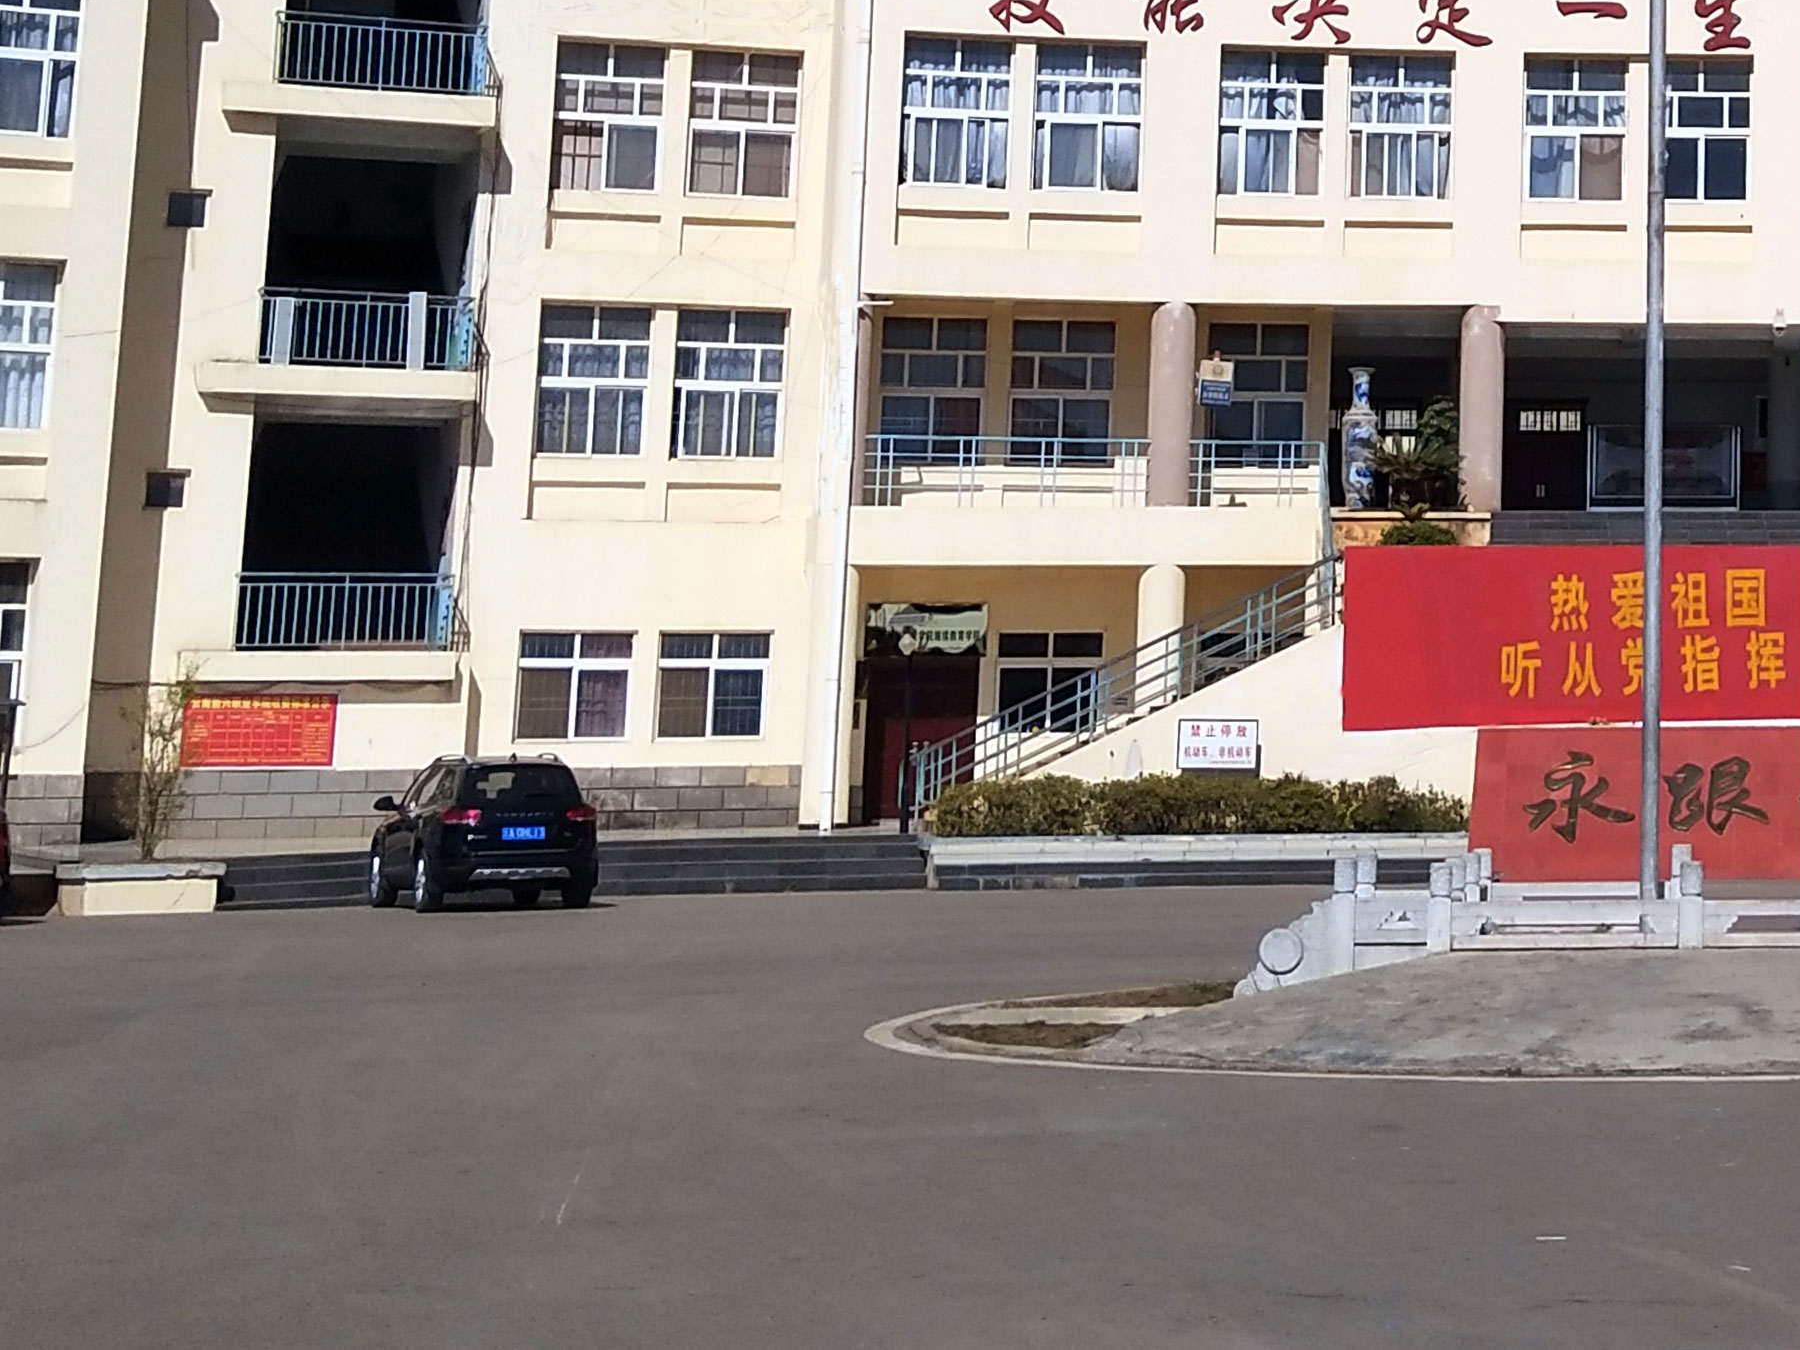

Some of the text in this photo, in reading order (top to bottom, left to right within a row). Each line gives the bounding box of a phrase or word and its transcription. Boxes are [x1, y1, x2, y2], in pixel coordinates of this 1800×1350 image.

[1550, 568, 1767, 632] 热爱祖国
[1500, 629, 1787, 699] 听从党指挥
[1190, 724, 1247, 738] 禁止停放
